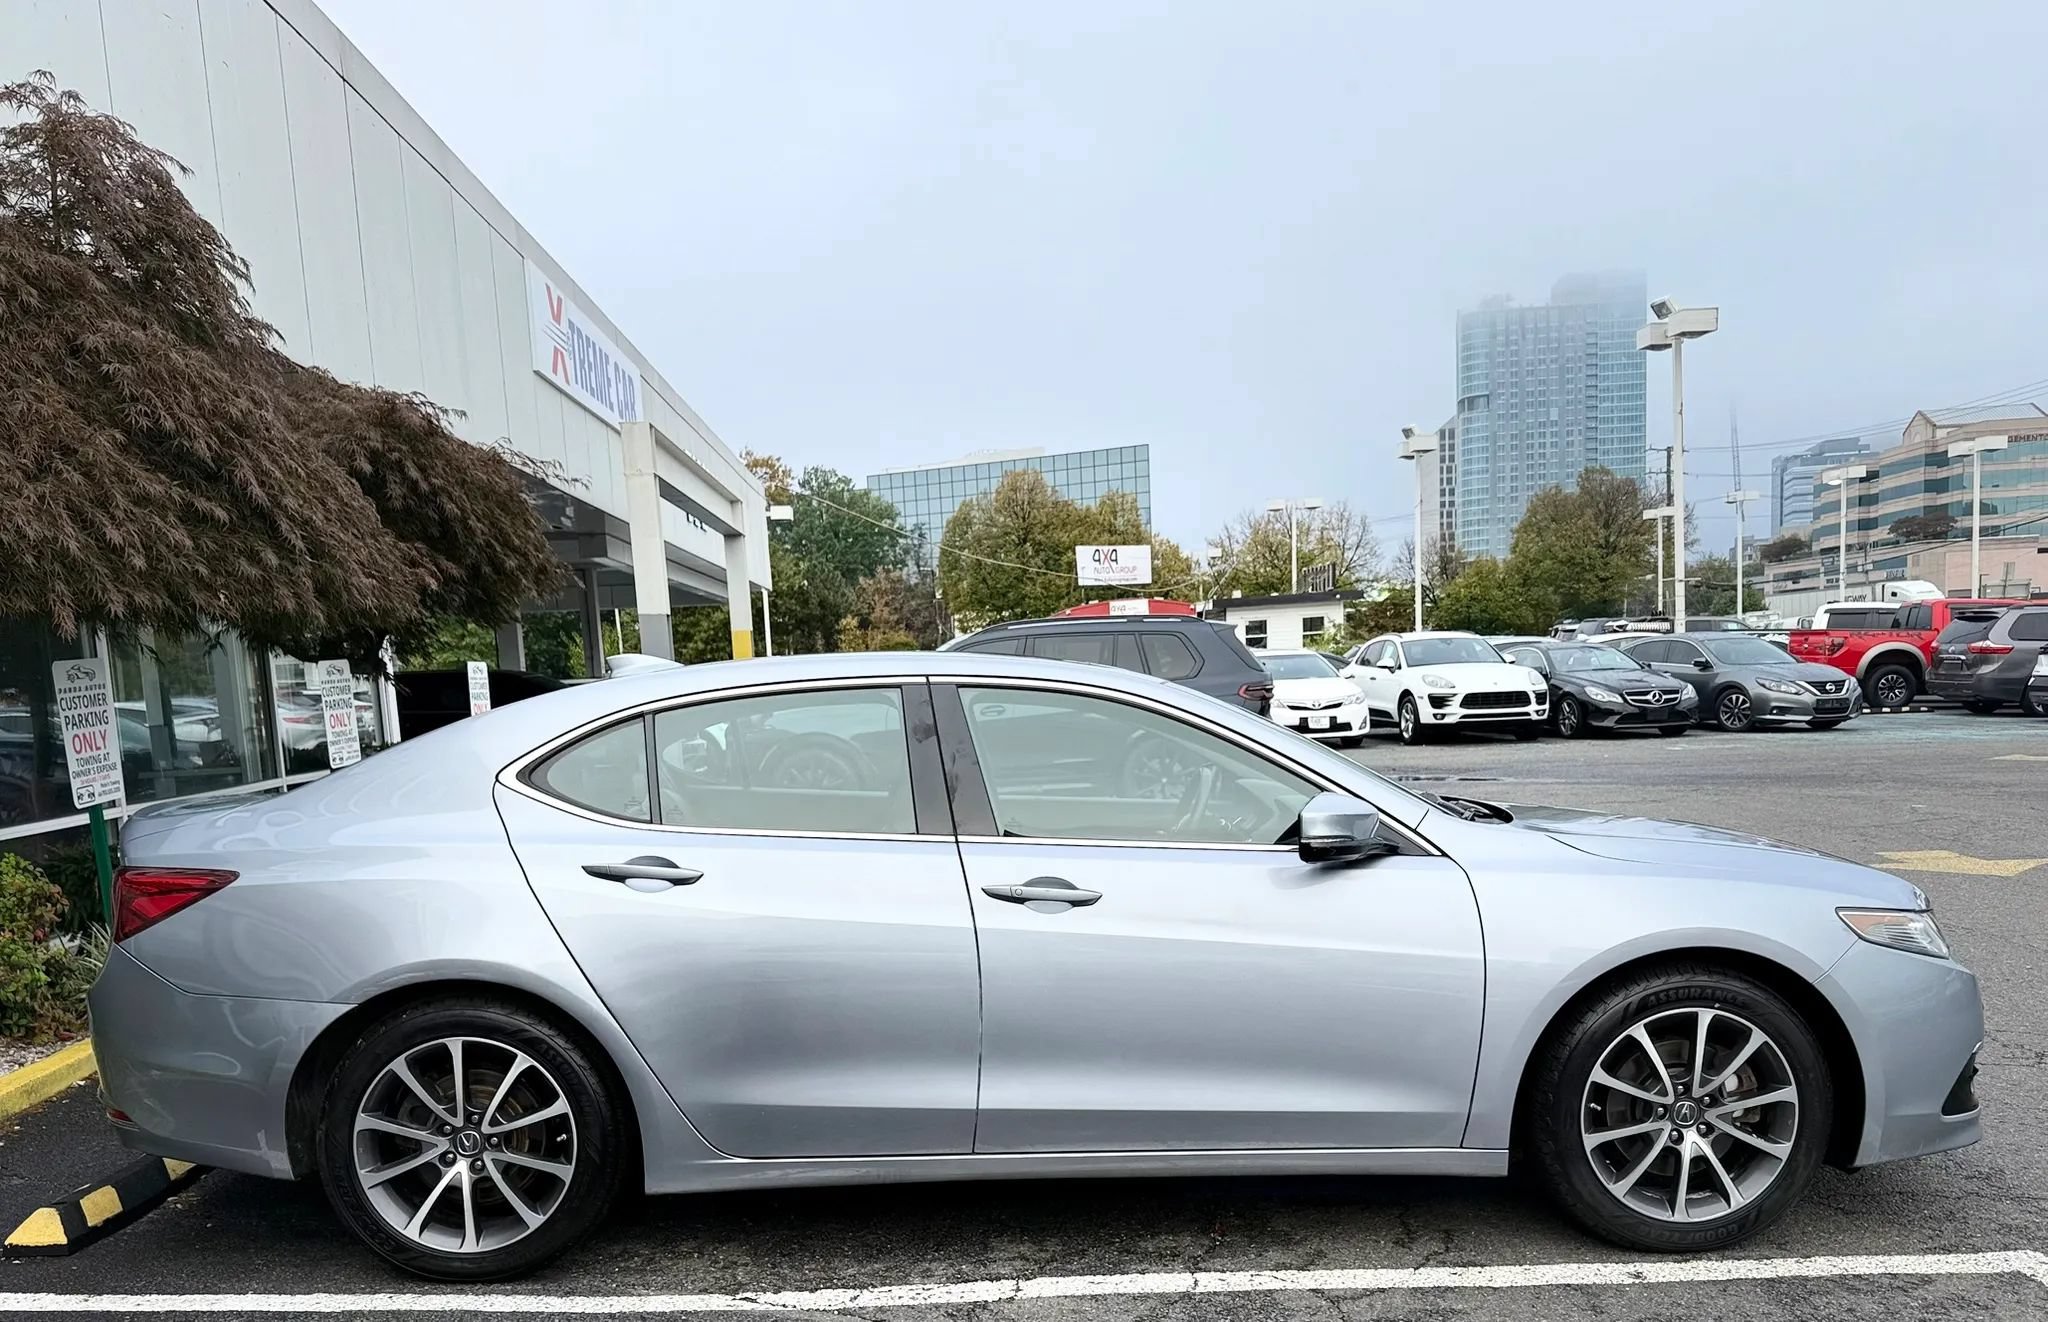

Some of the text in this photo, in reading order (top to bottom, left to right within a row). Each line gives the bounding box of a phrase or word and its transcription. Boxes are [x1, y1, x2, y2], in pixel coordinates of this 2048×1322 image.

[544, 282, 637, 423] XTREME CAR
[322, 684, 351, 697] CUSTOMER
[60, 693, 108, 711] CUSTOMER
[325, 697, 352, 712] PARKING
[64, 709, 109, 731] PARKING
[329, 711, 351, 729] ONLY
[72, 728, 107, 754] ONLY
[76, 752, 110, 768] TOWING AT
[72, 766, 96, 779] OWNER'S
[96, 762, 118, 774] EXPENSE
